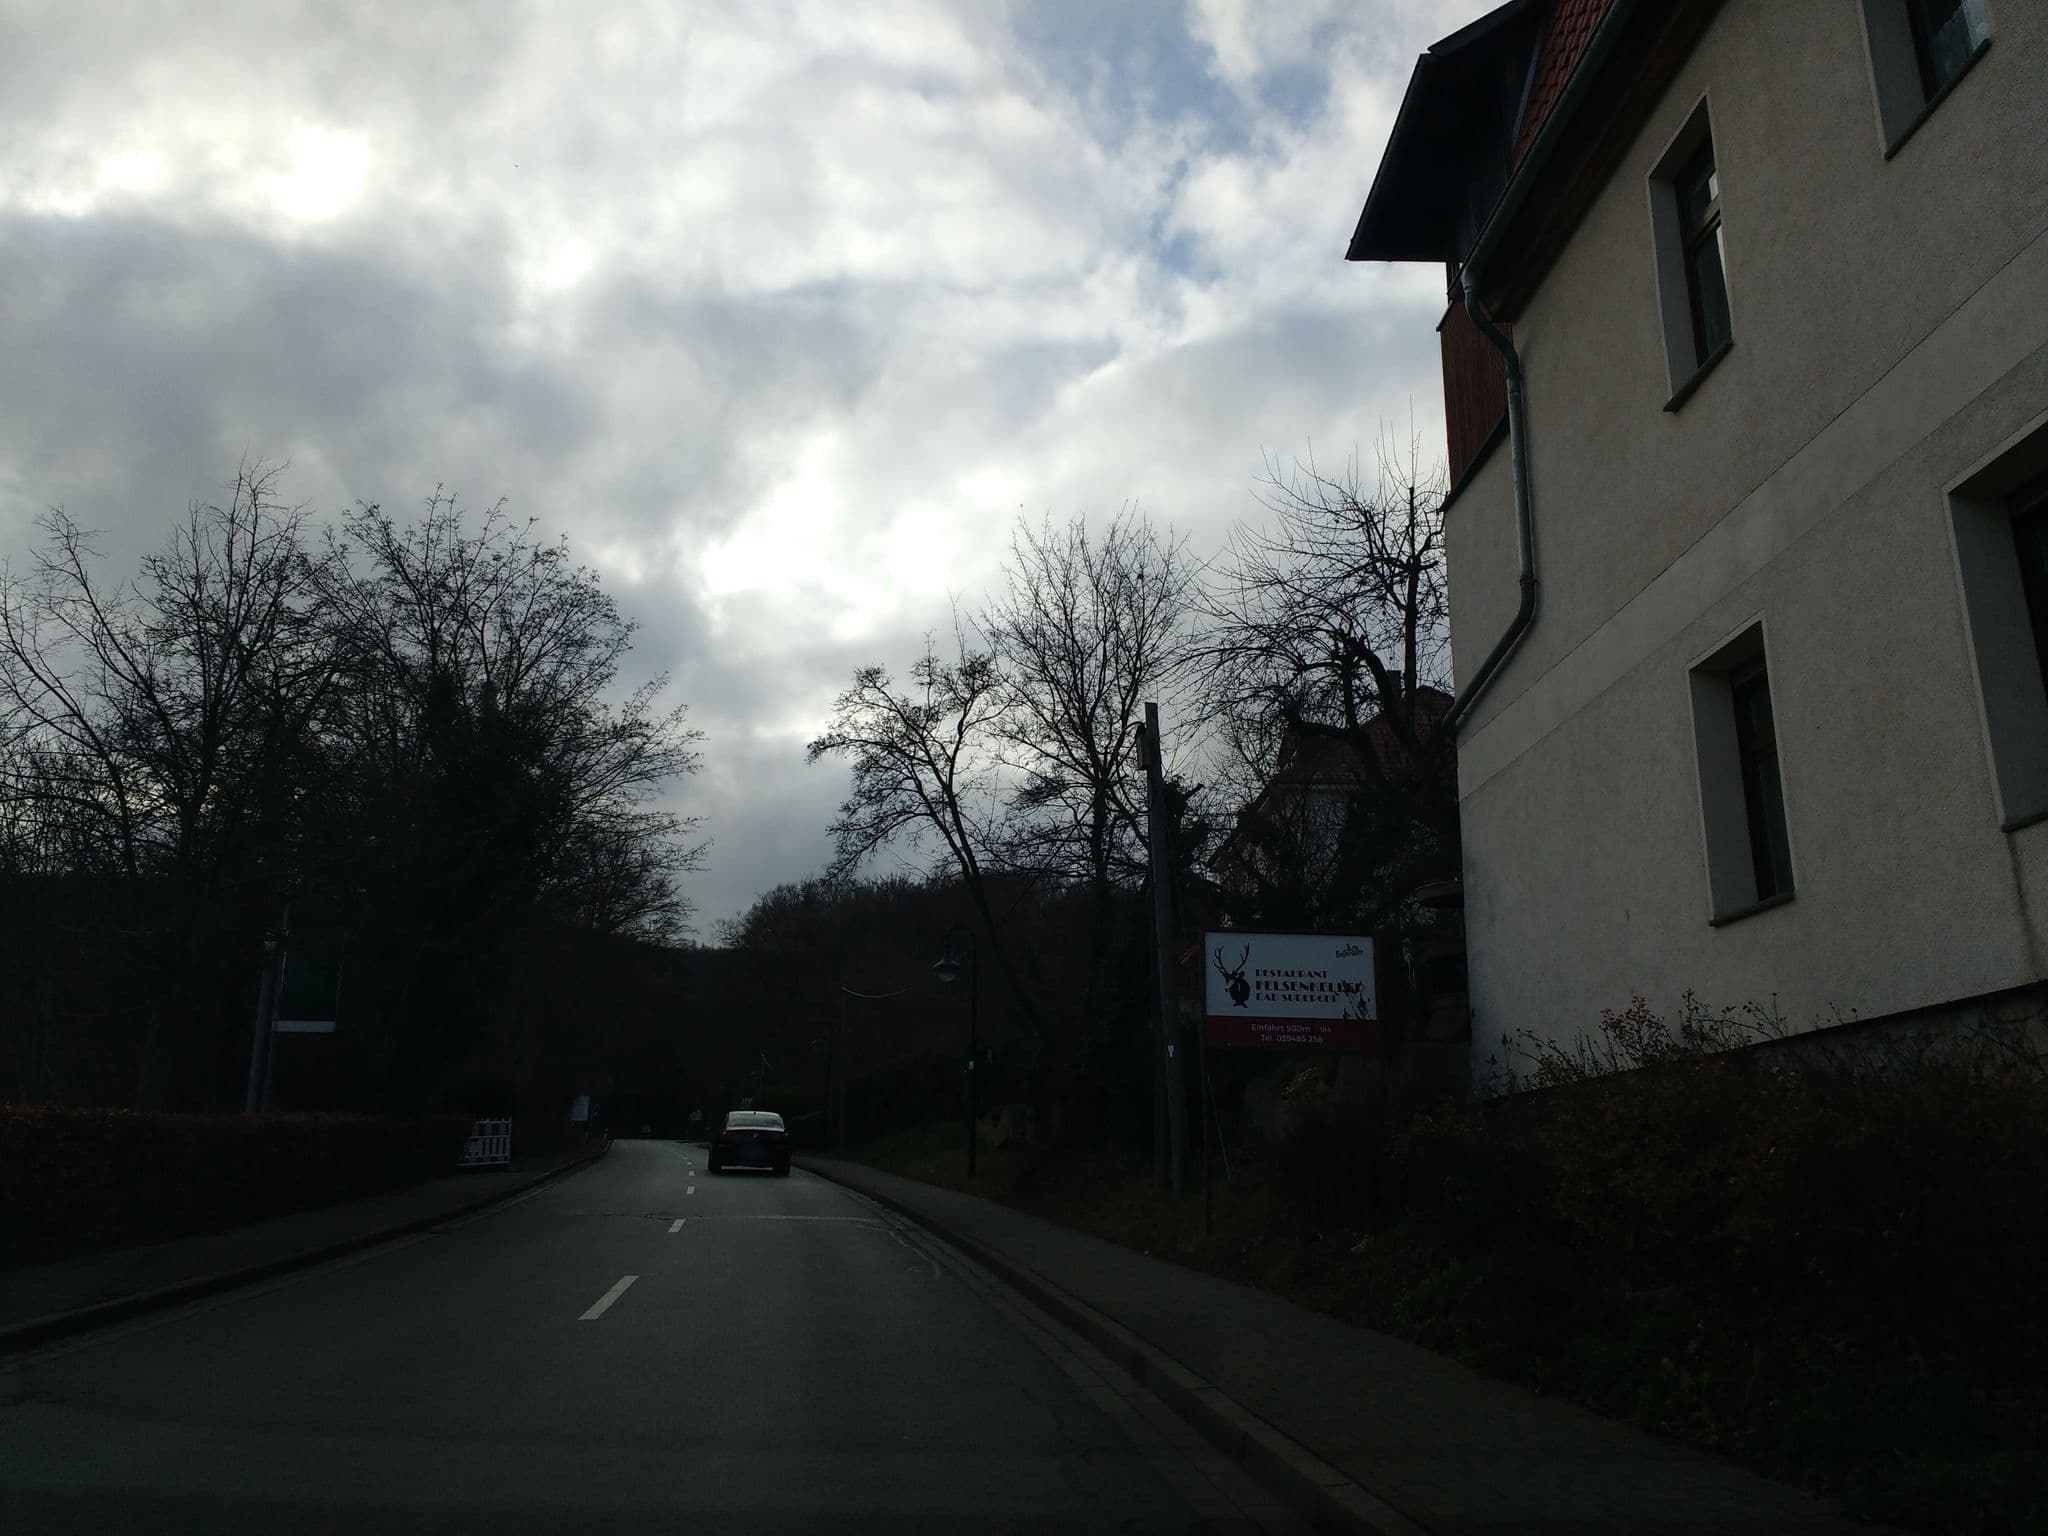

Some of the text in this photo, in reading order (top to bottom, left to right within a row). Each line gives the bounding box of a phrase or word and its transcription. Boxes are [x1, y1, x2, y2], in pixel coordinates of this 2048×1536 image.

[1255, 969, 1327, 978] RESTAURANT
[1256, 993, 1337, 1003] BAD SUDERODE
[1251, 1024, 1284, 1032] Einfahrt
[1286, 1024, 1311, 1033] 500m
